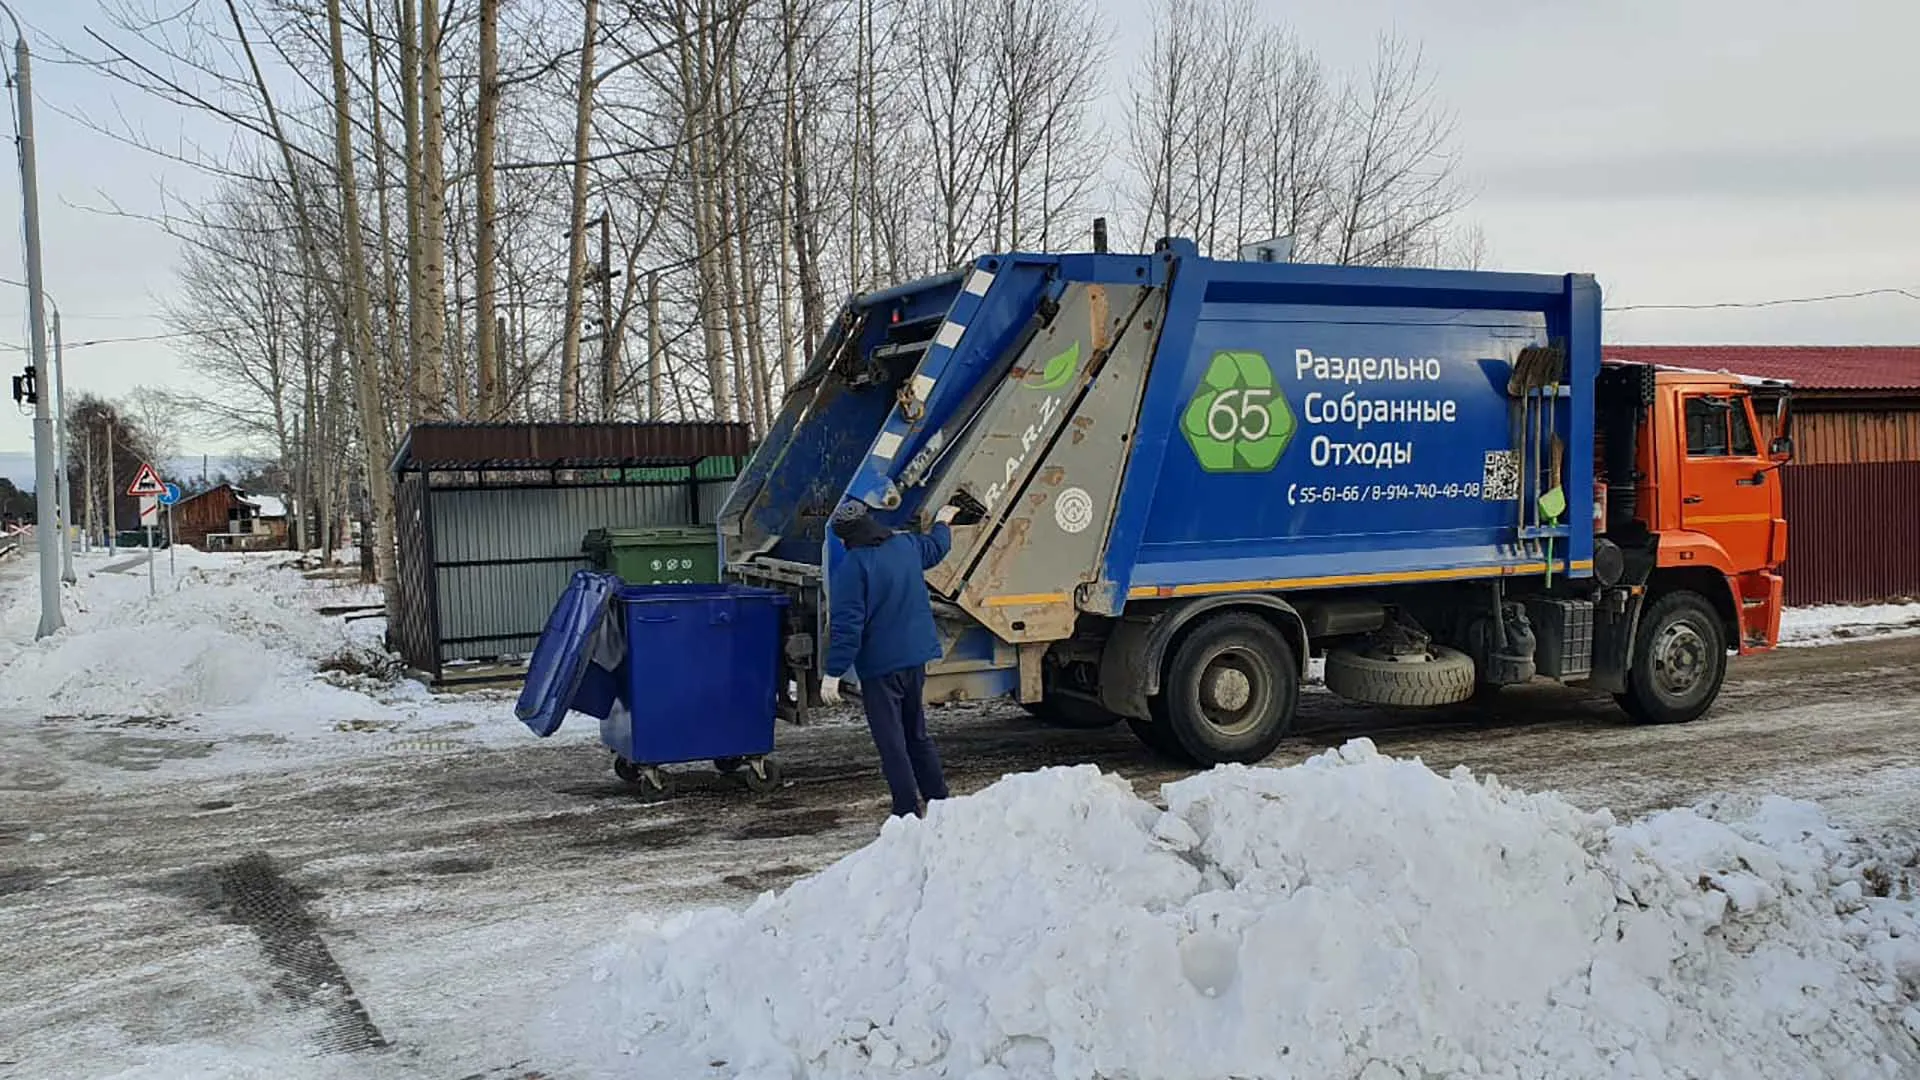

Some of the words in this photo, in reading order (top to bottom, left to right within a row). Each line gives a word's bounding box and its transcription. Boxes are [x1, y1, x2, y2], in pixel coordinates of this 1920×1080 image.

[1296, 349, 1441, 384] Раздельно
[1208, 389, 1271, 440] 65
[1305, 391, 1456, 429] Собранные
[1311, 435, 1412, 469] Отходы
[1300, 486, 1359, 503] 55-61-66
[1372, 483, 1480, 500] 8-914-740-49-08
